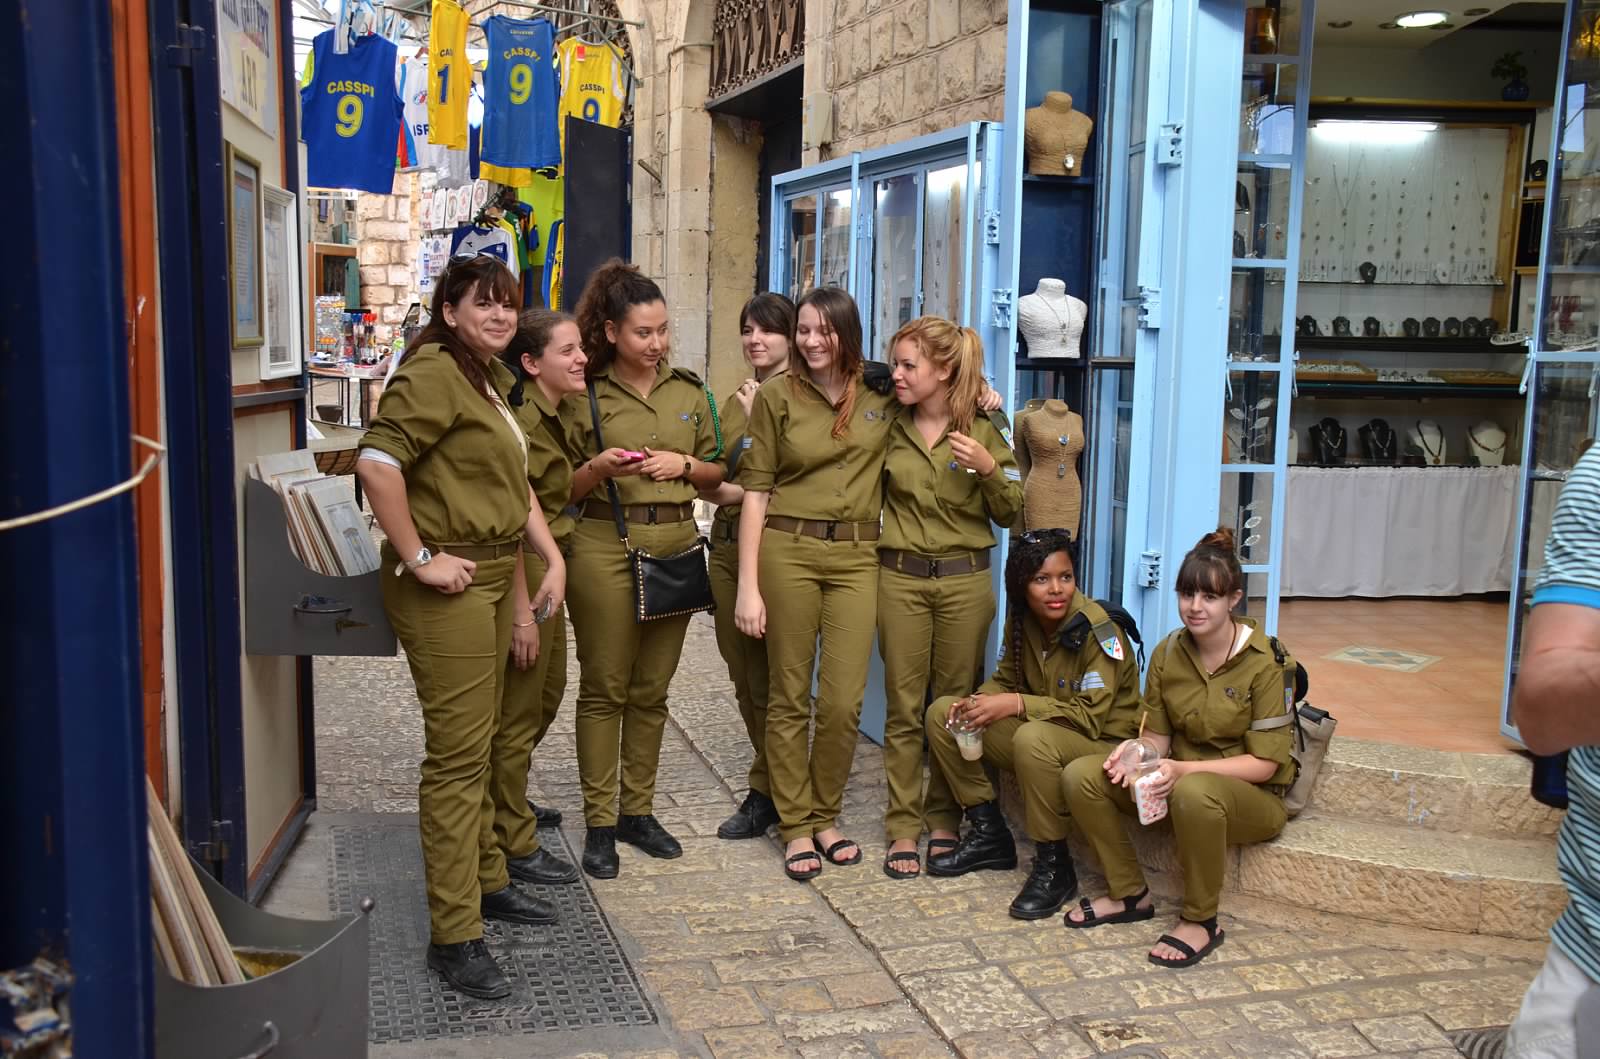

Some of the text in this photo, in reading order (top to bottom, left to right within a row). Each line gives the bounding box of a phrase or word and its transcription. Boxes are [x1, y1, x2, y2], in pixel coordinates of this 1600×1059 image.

[503, 47, 541, 62] CASSPI
[241, 49, 258, 111] ART
[327, 80, 375, 97] CASSPI
[437, 63, 450, 105] 1
[509, 63, 533, 105] 9
[579, 83, 605, 95] CASSPI
[335, 94, 364, 138] 9
